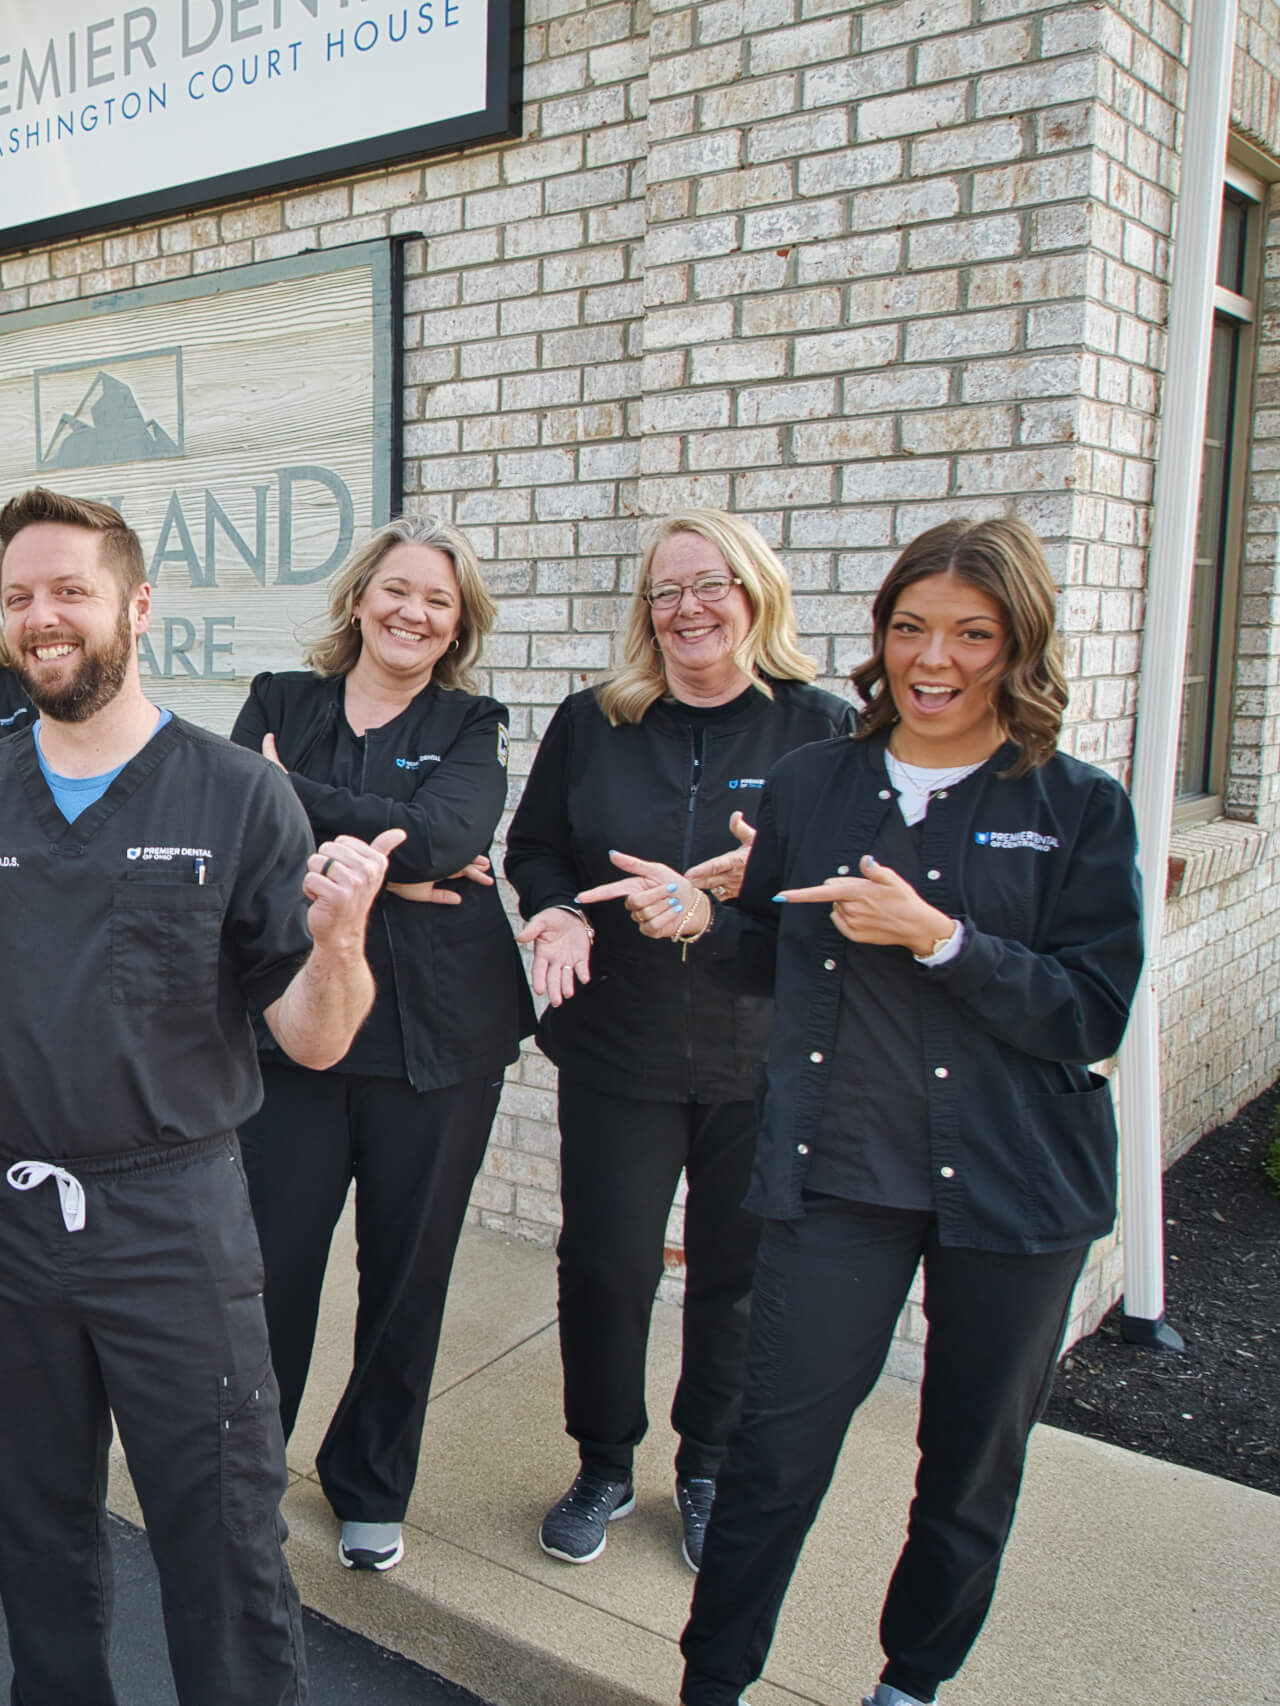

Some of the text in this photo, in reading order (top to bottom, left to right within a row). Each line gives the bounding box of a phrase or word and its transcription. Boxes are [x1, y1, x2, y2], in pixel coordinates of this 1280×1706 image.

[188, 41, 303, 100] COURT
[326, 0, 459, 62] HOUSE
[144, 847, 213, 858] PREMIER DENTAL
